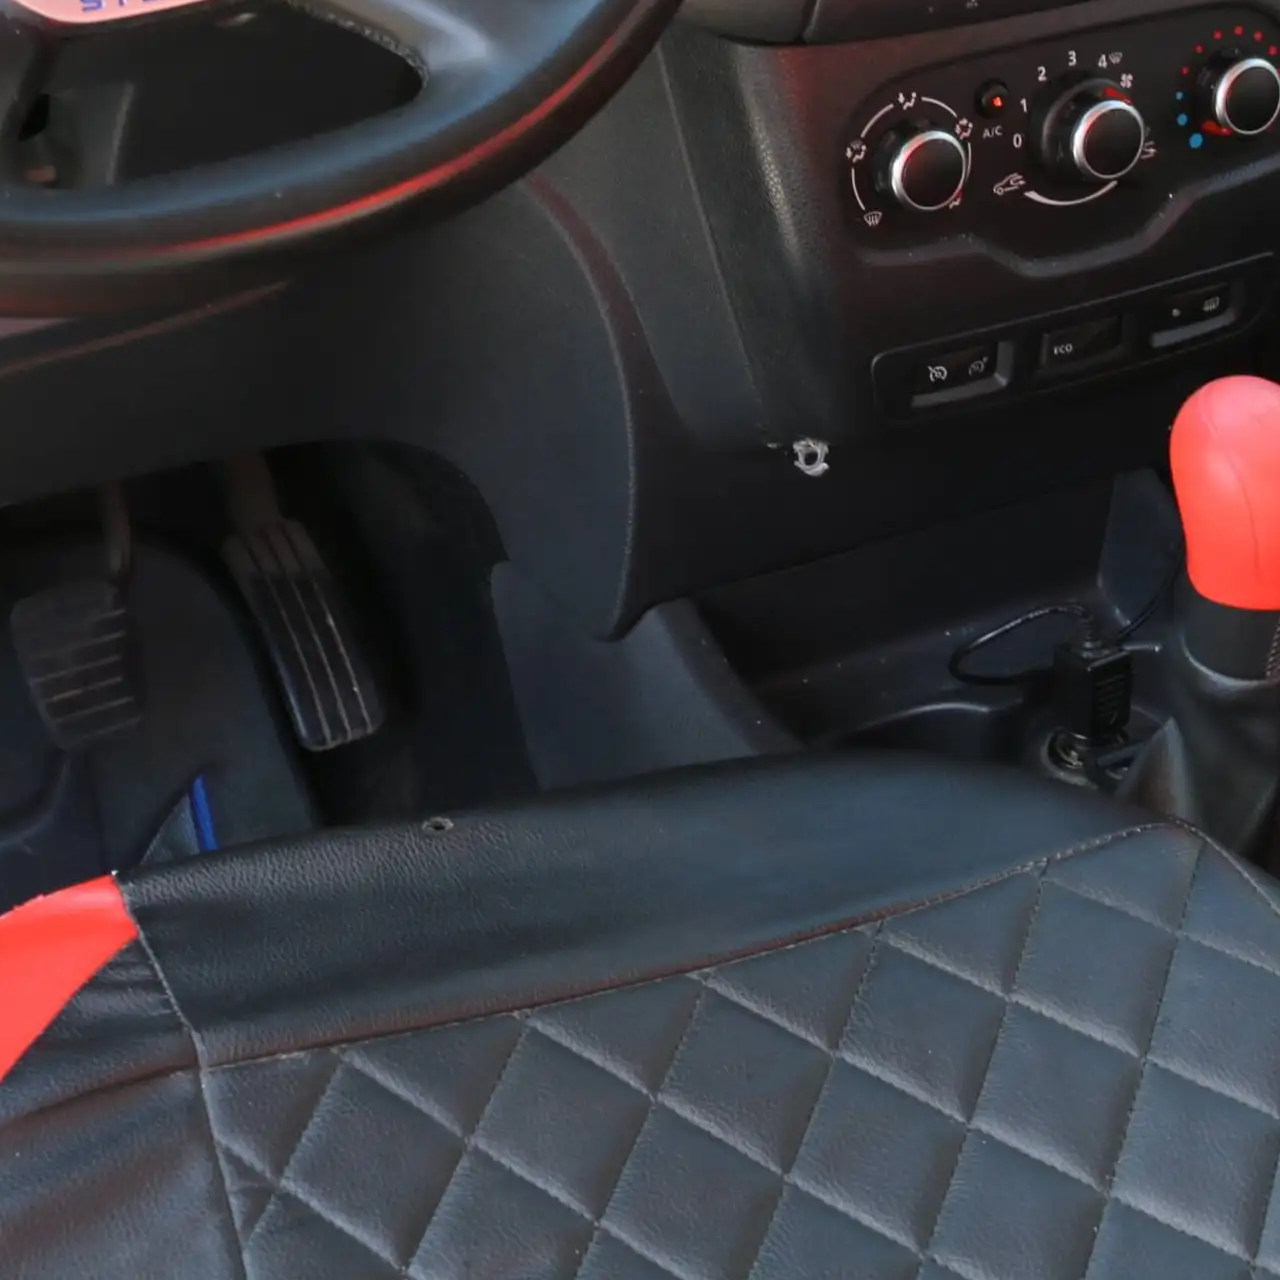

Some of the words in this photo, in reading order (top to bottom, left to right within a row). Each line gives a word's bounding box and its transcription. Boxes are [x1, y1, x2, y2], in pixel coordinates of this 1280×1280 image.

[1067, 50, 1077, 66] 3
[1098, 54, 1108, 69] 4
[1037, 66, 1047, 82] 2
[1020, 98, 1028, 113] 1
[982, 125, 1003, 139] A/C
[1012, 133, 1023, 149] 0
[1053, 343, 1073, 356] ECO
